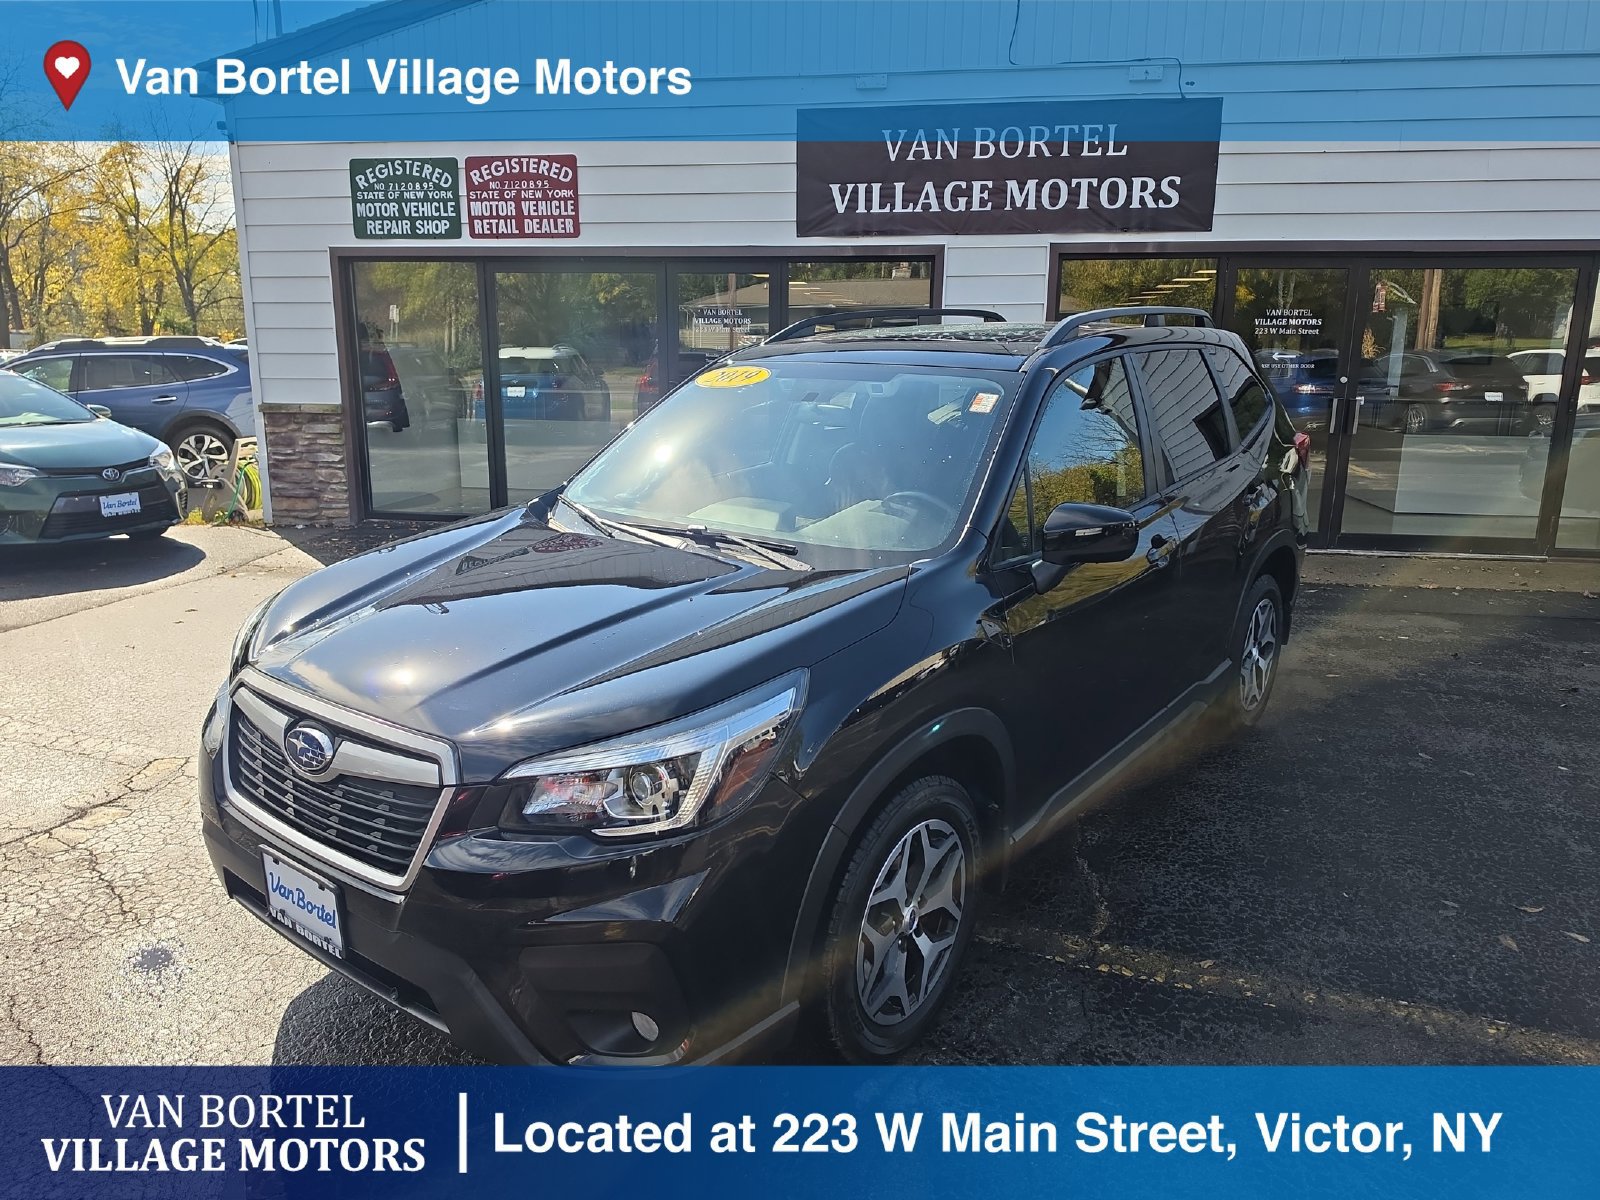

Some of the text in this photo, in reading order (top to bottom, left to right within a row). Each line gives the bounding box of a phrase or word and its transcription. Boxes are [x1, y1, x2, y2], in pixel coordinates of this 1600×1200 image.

[882, 123, 1128, 162] VAN BORTEL
[355, 159, 453, 190] REGISTERED
[470, 157, 573, 186] REGISTERED
[388, 182, 434, 190] 7120895
[502, 180, 550, 189] 7120895
[357, 190, 453, 200] STATE OF NEW YORK
[469, 189, 575, 199] STATE OF NEW YORK
[829, 176, 1181, 214] VILLAGE MOTORS
[356, 202, 456, 217] MOTOR VEHICLE
[470, 200, 575, 216] MOTOR VEHICLE
[366, 220, 450, 235] REPAIR SHOP
[474, 218, 574, 234] RETAIL DEALER
[1254, 318, 1322, 326] VILLAGE MOTORS
[103, 498, 137, 510] Van Bortel
[269, 906, 343, 960] VAN BORTEL
